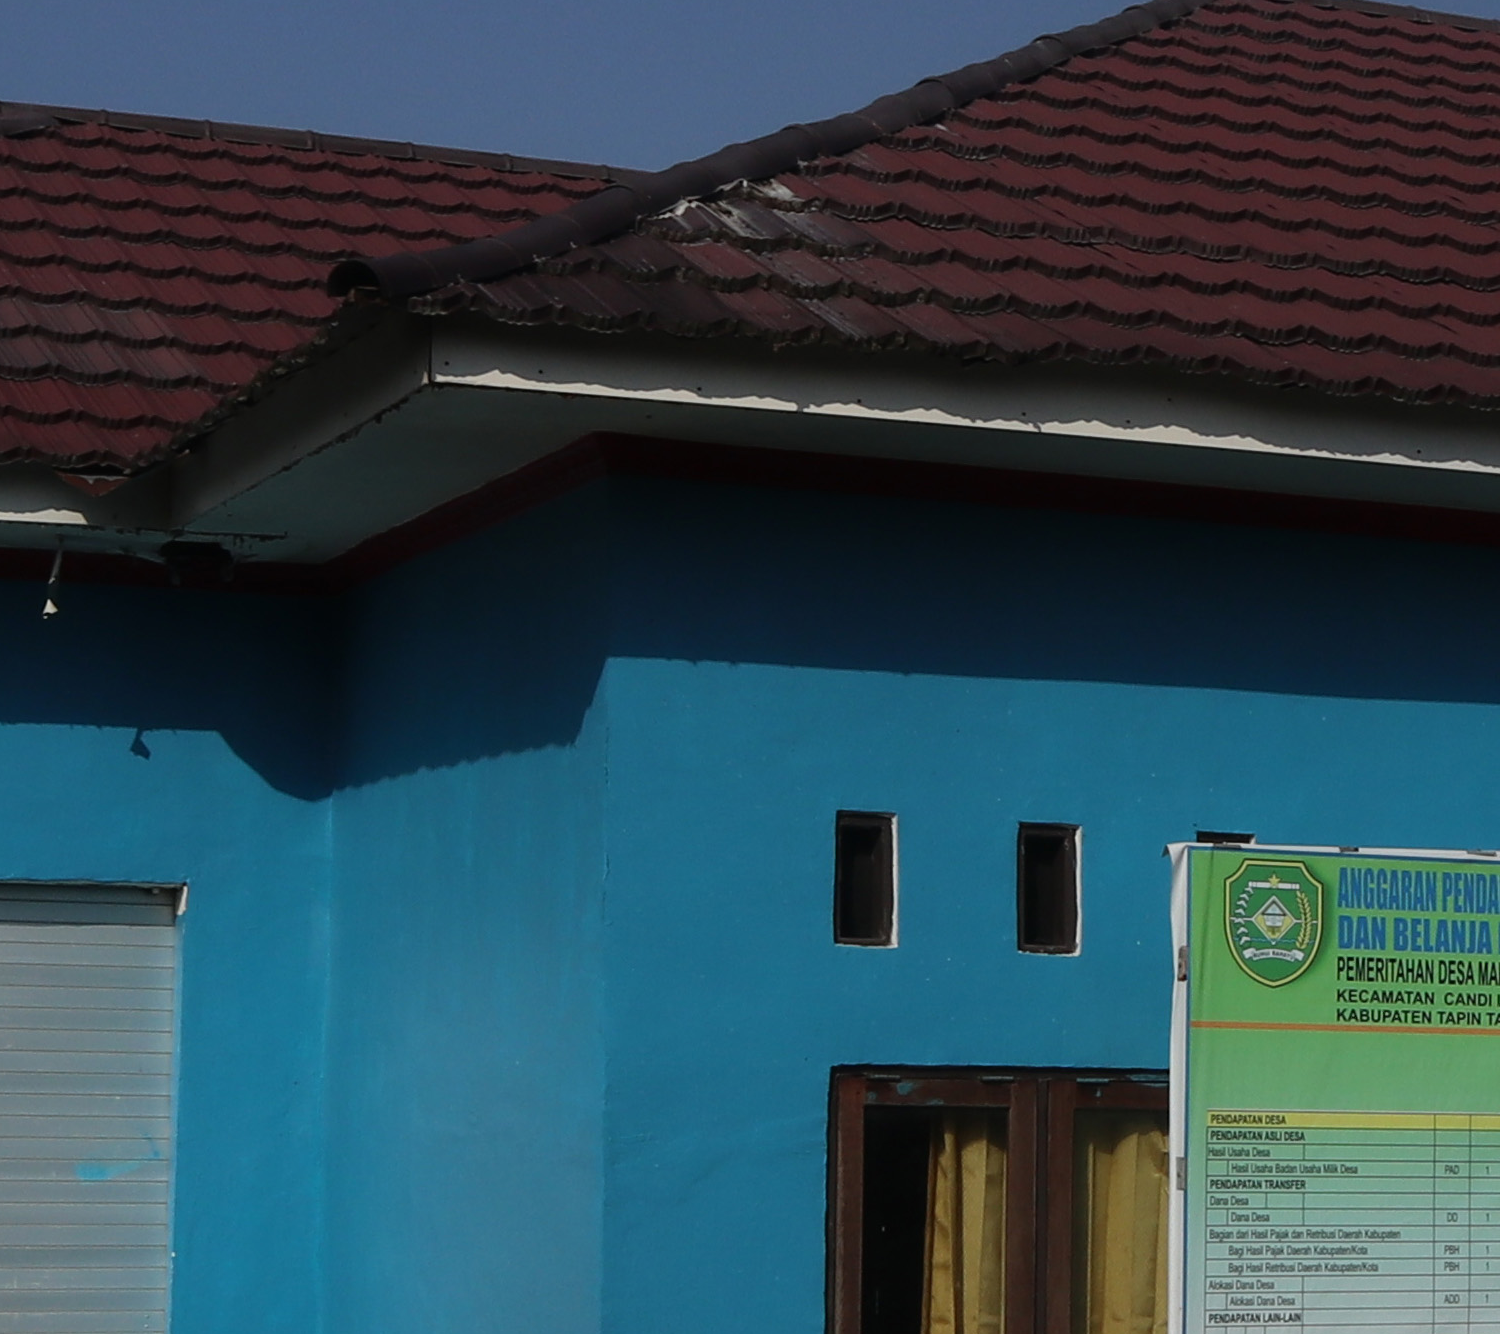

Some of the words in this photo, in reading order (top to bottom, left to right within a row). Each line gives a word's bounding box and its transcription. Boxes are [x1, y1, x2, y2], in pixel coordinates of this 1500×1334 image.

[1338, 866, 1437, 912] ANGGARAN
[1338, 915, 1386, 951] DAN
[1393, 917, 1492, 955] BELANJA
[1337, 956, 1434, 984] PEMERITAHAN
[1438, 960, 1475, 985] DESA
[1337, 989, 1435, 1005] KECAMATAN
[1444, 993, 1492, 1007] CANDI
[1337, 1009, 1432, 1025] KABUPATEN
[1436, 1011, 1480, 1027] TAPIN
[1210, 1114, 1263, 1125] PENDAPATAN
[1265, 1114, 1286, 1125] DESA
[1210, 1130, 1263, 1141] PENDAPATAN
[1264, 1131, 1282, 1142] ASLI
[1283, 1131, 1305, 1142] DESA
[1208, 1146, 1226, 1157] Hasil
[1227, 1147, 1250, 1157] Usaha
[1252, 1147, 1270, 1157] Desa
[1209, 1179, 1262, 1190] PENDAPATAN
[1265, 1179, 1306, 1190] TRANSFER
[1208, 1312, 1261, 1324] PENDAPATAN
[1263, 1312, 1300, 1323] LAIN-LAIN
